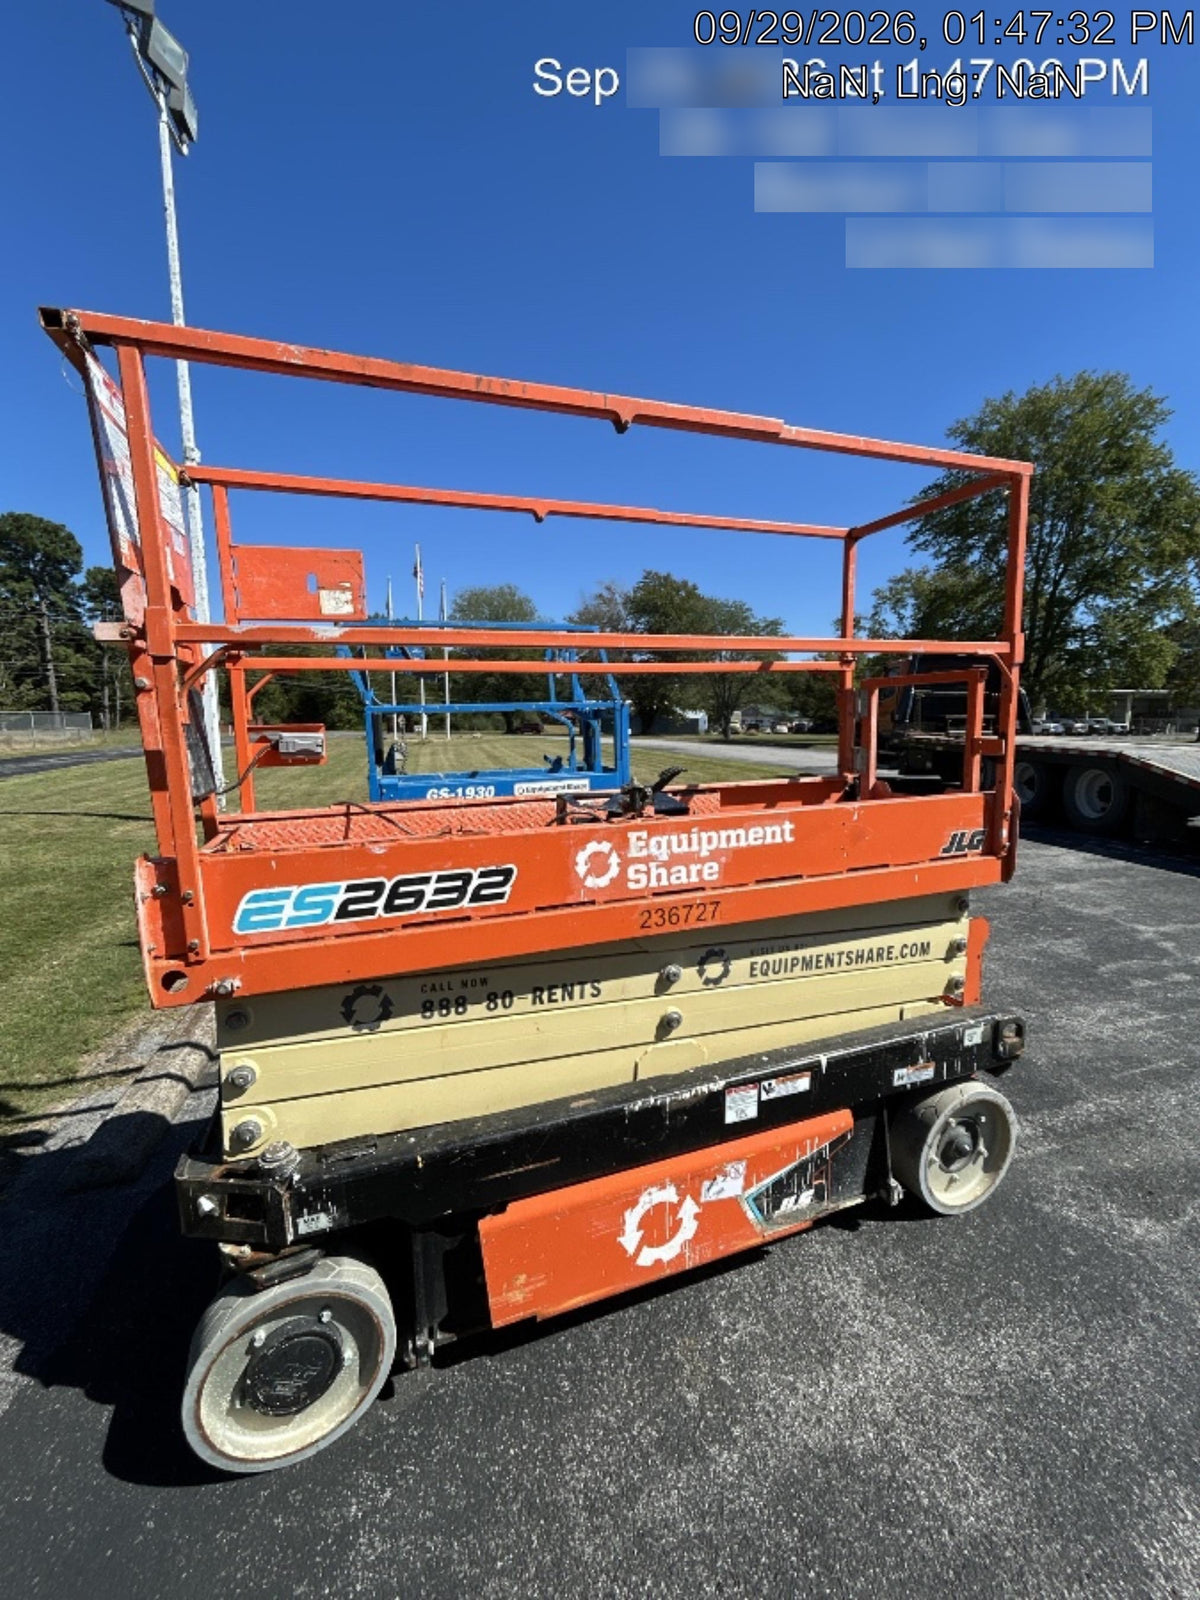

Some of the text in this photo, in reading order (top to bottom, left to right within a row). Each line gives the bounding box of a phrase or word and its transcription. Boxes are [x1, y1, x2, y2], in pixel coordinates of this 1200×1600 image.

[425, 784, 496, 801] GS-1930
[627, 820, 796, 862] Equipment
[940, 829, 987, 855] JLG
[626, 861, 720, 890] Share
[234, 865, 517, 934] ES2632
[639, 901, 722, 930] 236727
[748, 941, 932, 978] EQUIPMENTSHARE.COM
[420, 976, 489, 994] CALL NOW
